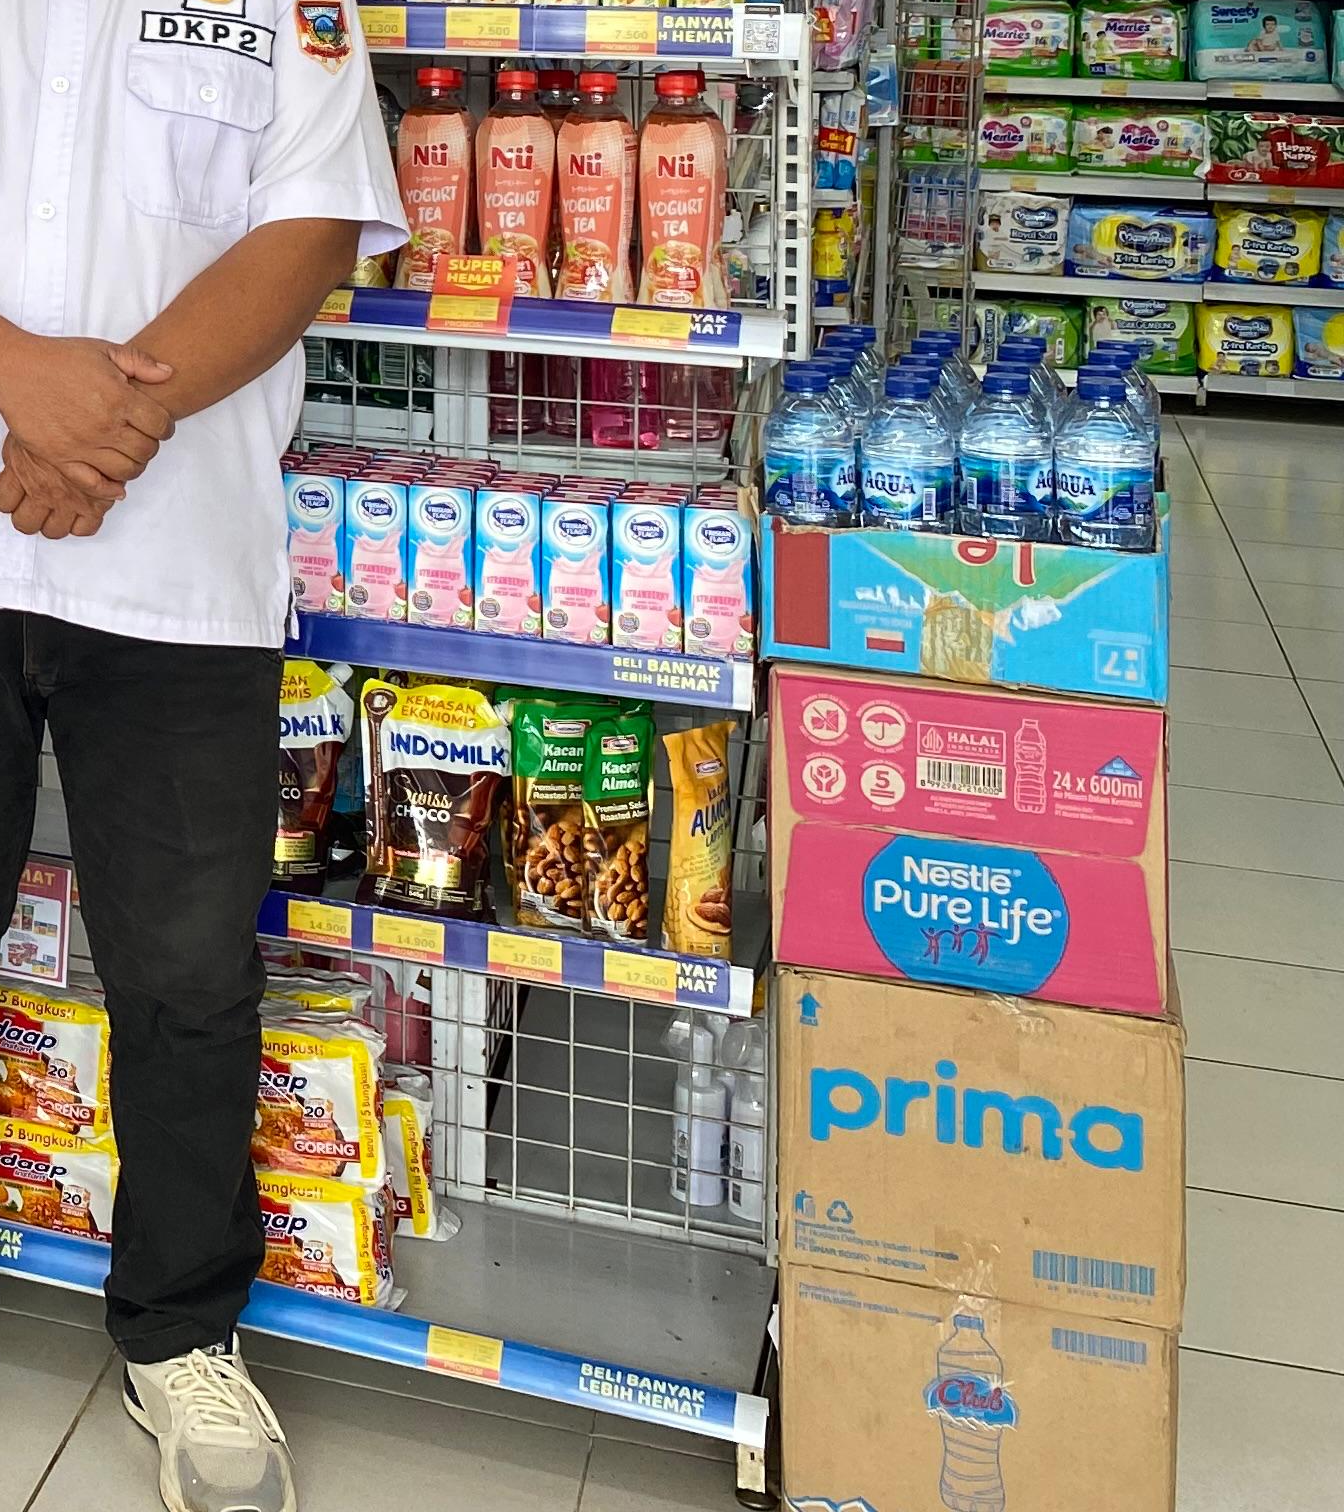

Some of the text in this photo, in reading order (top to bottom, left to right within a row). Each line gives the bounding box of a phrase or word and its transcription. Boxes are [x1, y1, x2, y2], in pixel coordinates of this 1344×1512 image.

[477, 26, 511, 36] 7.500
[406, 187, 457, 206] YOGURT
[418, 206, 442, 223] TEA
[648, 198, 704, 218] YOGURT
[662, 219, 689, 236] TEA
[447, 258, 503, 275] SUPER
[446, 271, 502, 286] HEMAT
[864, 472, 915, 497] AQUA
[613, 657, 721, 679] BELI BANYAK
[613, 671, 719, 693] LEBIH HEMAT
[405, 695, 476, 714] KEMASAN
[390, 731, 506, 767] INDOMILK
[948, 732, 999, 748] HALAL
[1053, 771, 1142, 799] 24 x 600ml
[395, 803, 449, 824] CHOCO
[874, 879, 1054, 945] Pure Life
[309, 920, 347, 936] 14.900
[625, 972, 668, 987] 17.500
[810, 1059, 1145, 1173] prima
[294, 1141, 356, 1156] GORENG
[580, 1363, 706, 1403] BELI BANYAK
[579, 1376, 704, 1418] LEBIH HEMAT
[936, 1378, 1003, 1411] Club
